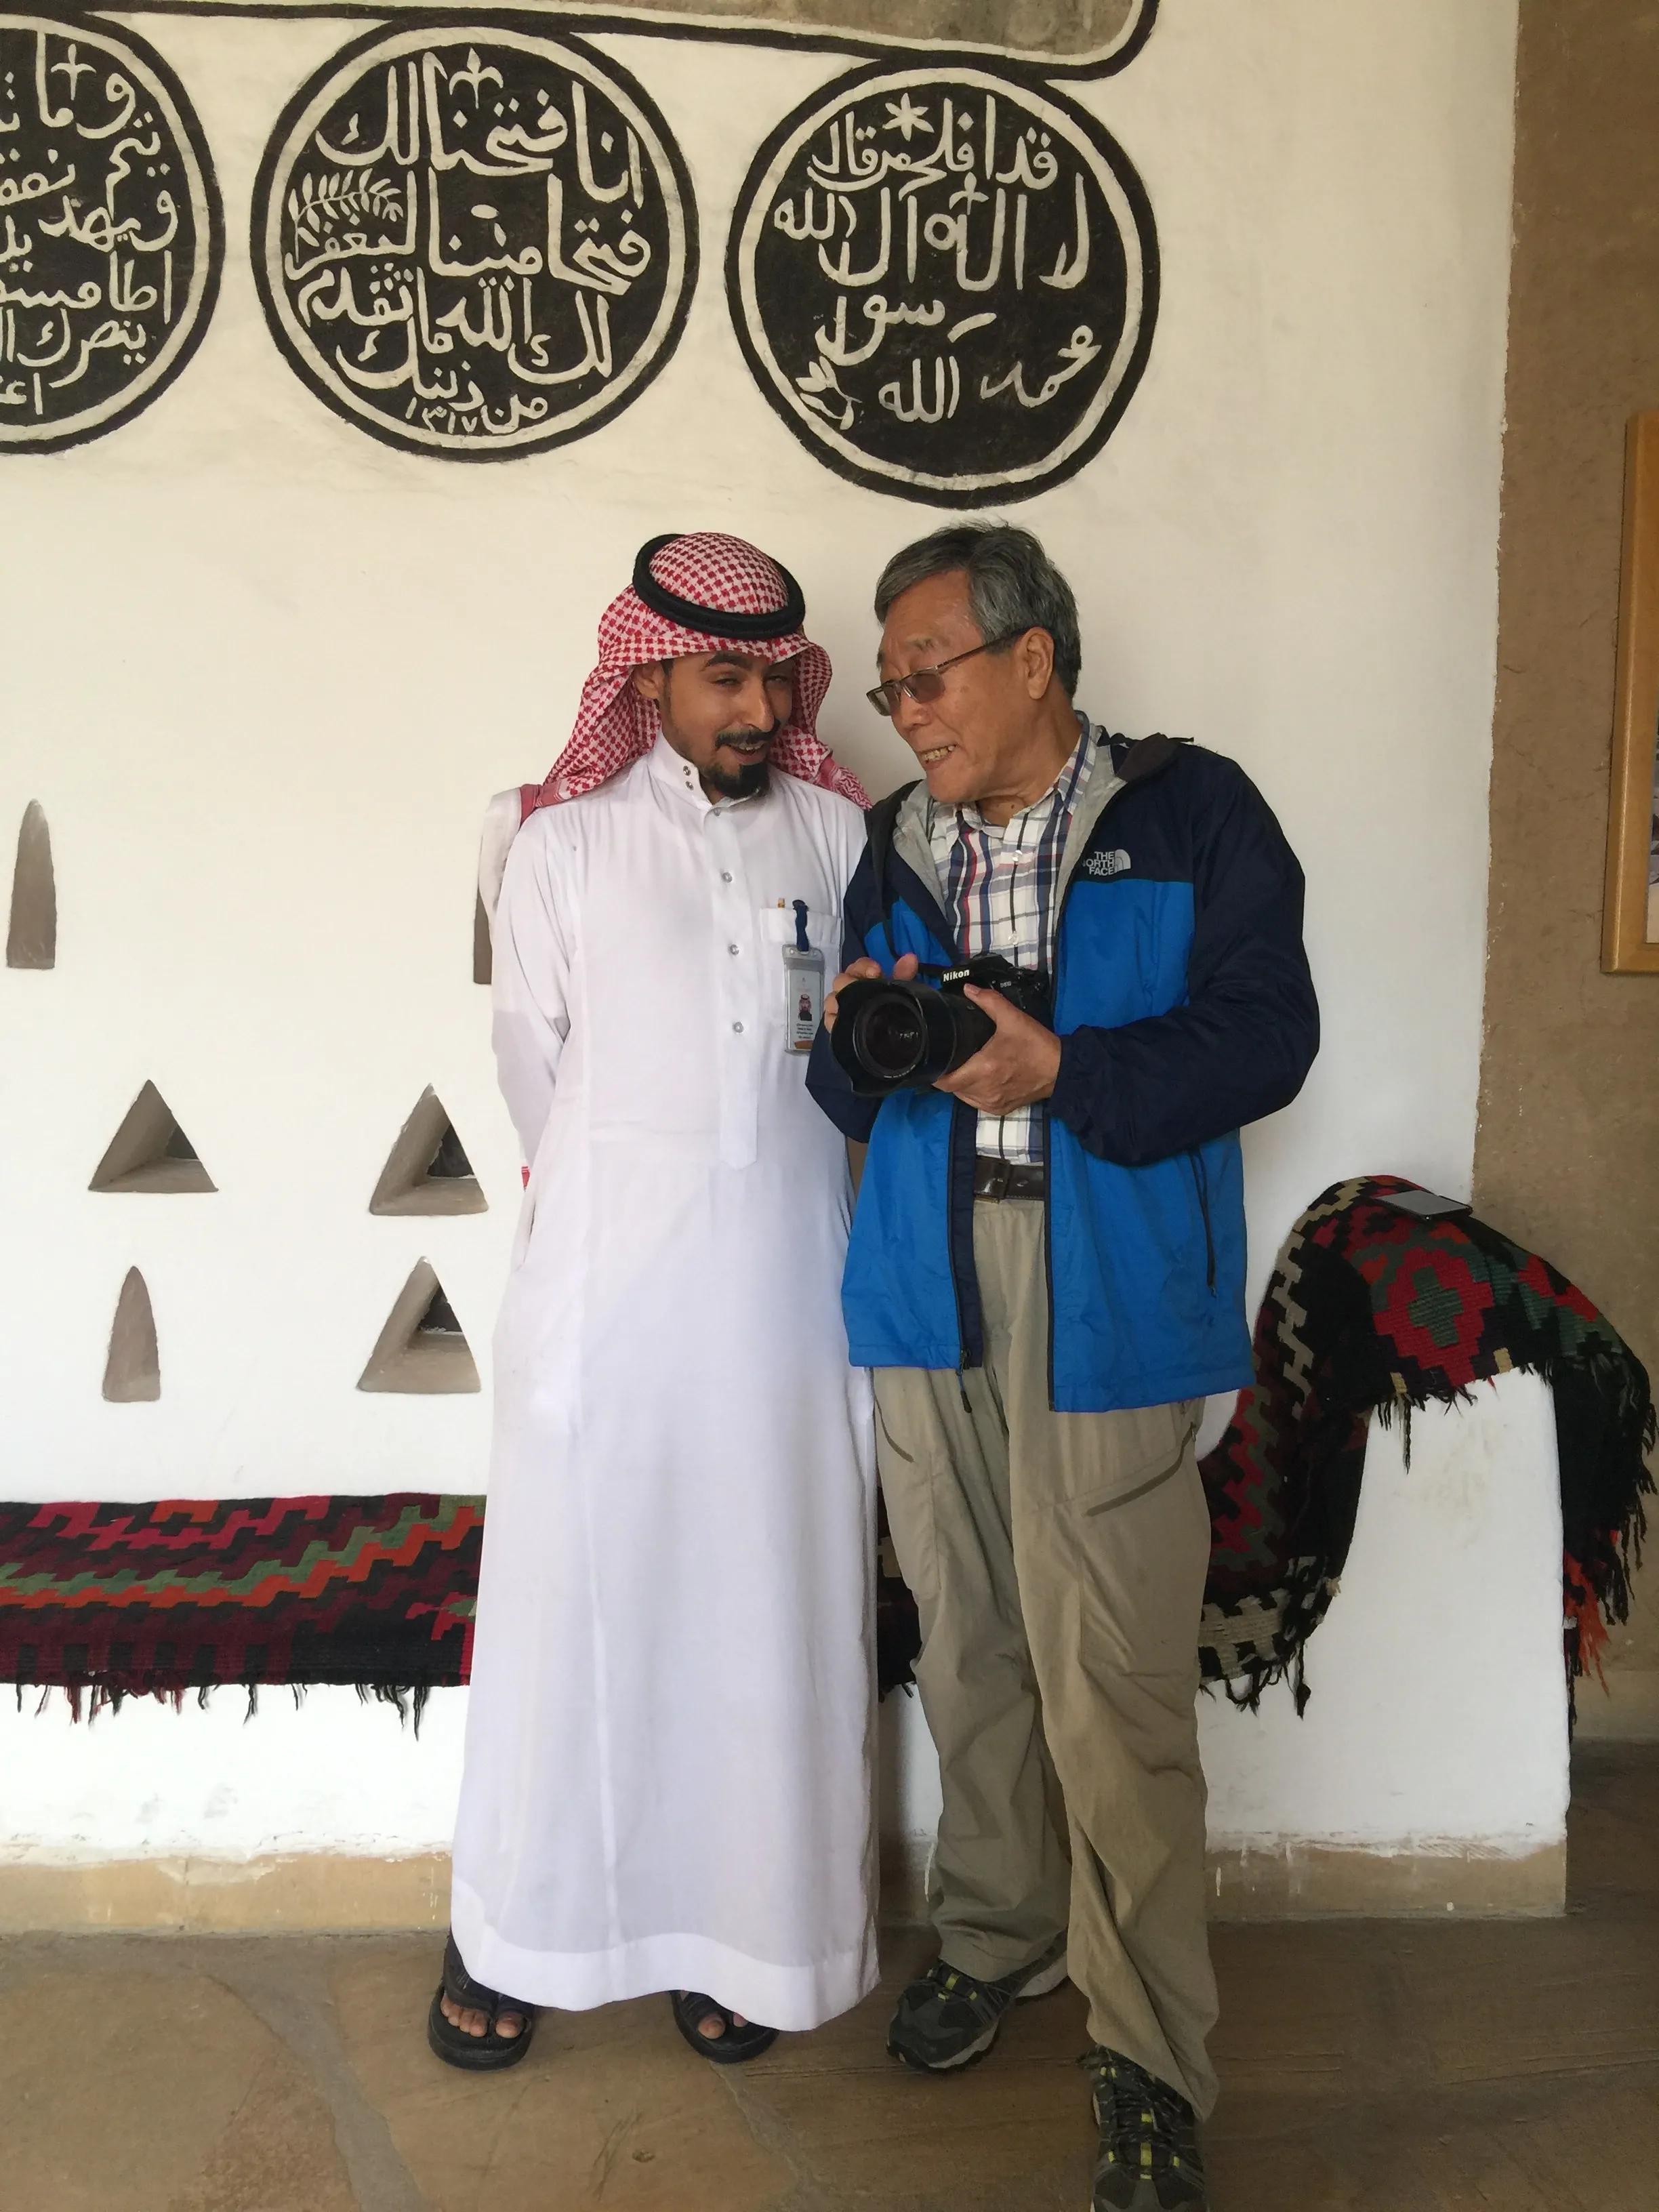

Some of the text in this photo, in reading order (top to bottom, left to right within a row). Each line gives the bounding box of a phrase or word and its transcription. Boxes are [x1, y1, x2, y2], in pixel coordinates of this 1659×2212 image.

[315, 60, 420, 166] لك
[571, 80, 644, 209] انا
[812, 110, 878, 176] قال
[996, 127, 1058, 190] قد
[547, 173, 652, 296] فتحا
[773, 173, 1090, 291] لا اله الا الله
[507, 290, 613, 386] لك
[814, 293, 1103, 424] محمد رسول الله
[480, 393, 549, 435] من
[1088, 867, 1115, 876] FACE
[1094, 851, 1115, 860] THE
[943, 969, 970, 982] Nikon
